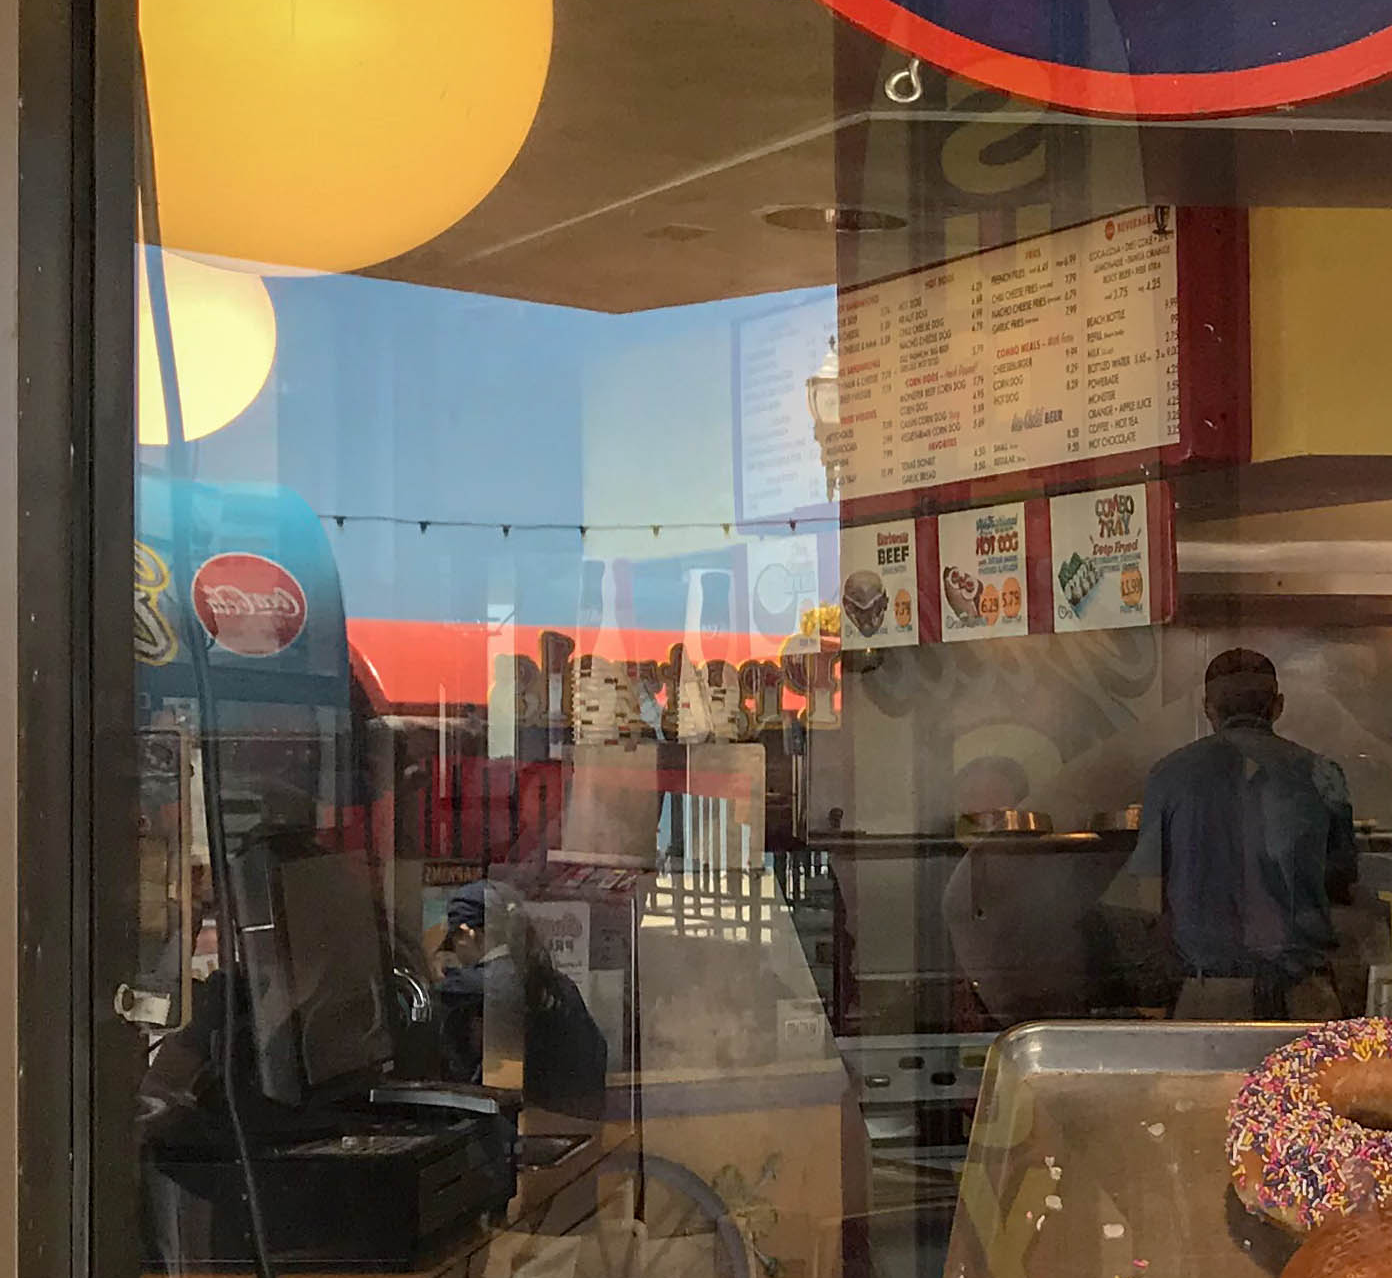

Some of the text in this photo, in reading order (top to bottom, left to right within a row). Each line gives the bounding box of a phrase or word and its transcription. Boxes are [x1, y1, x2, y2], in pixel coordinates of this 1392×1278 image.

[1095, 494, 1134, 518] COMBO
[1098, 516, 1131, 538] TRAY
[877, 546, 910, 565] BEEF
[976, 535, 995, 555] HOT
